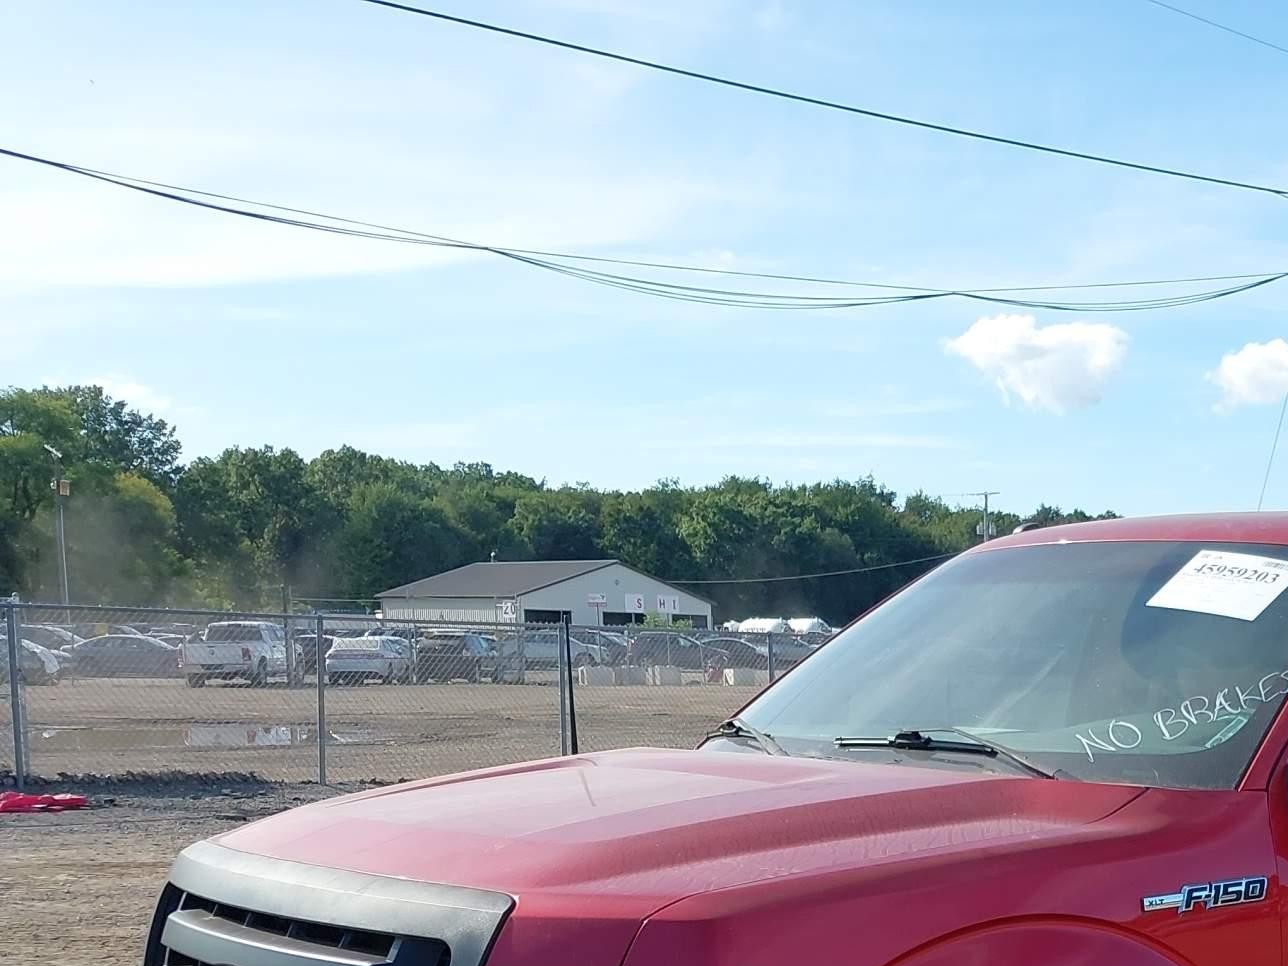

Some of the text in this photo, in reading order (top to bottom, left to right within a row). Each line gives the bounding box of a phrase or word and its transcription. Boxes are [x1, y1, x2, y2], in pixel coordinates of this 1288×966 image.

[1194, 563, 1280, 584] 45959203
[1075, 719, 1142, 763] NO
[1147, 877, 1268, 911] XLT F-150
